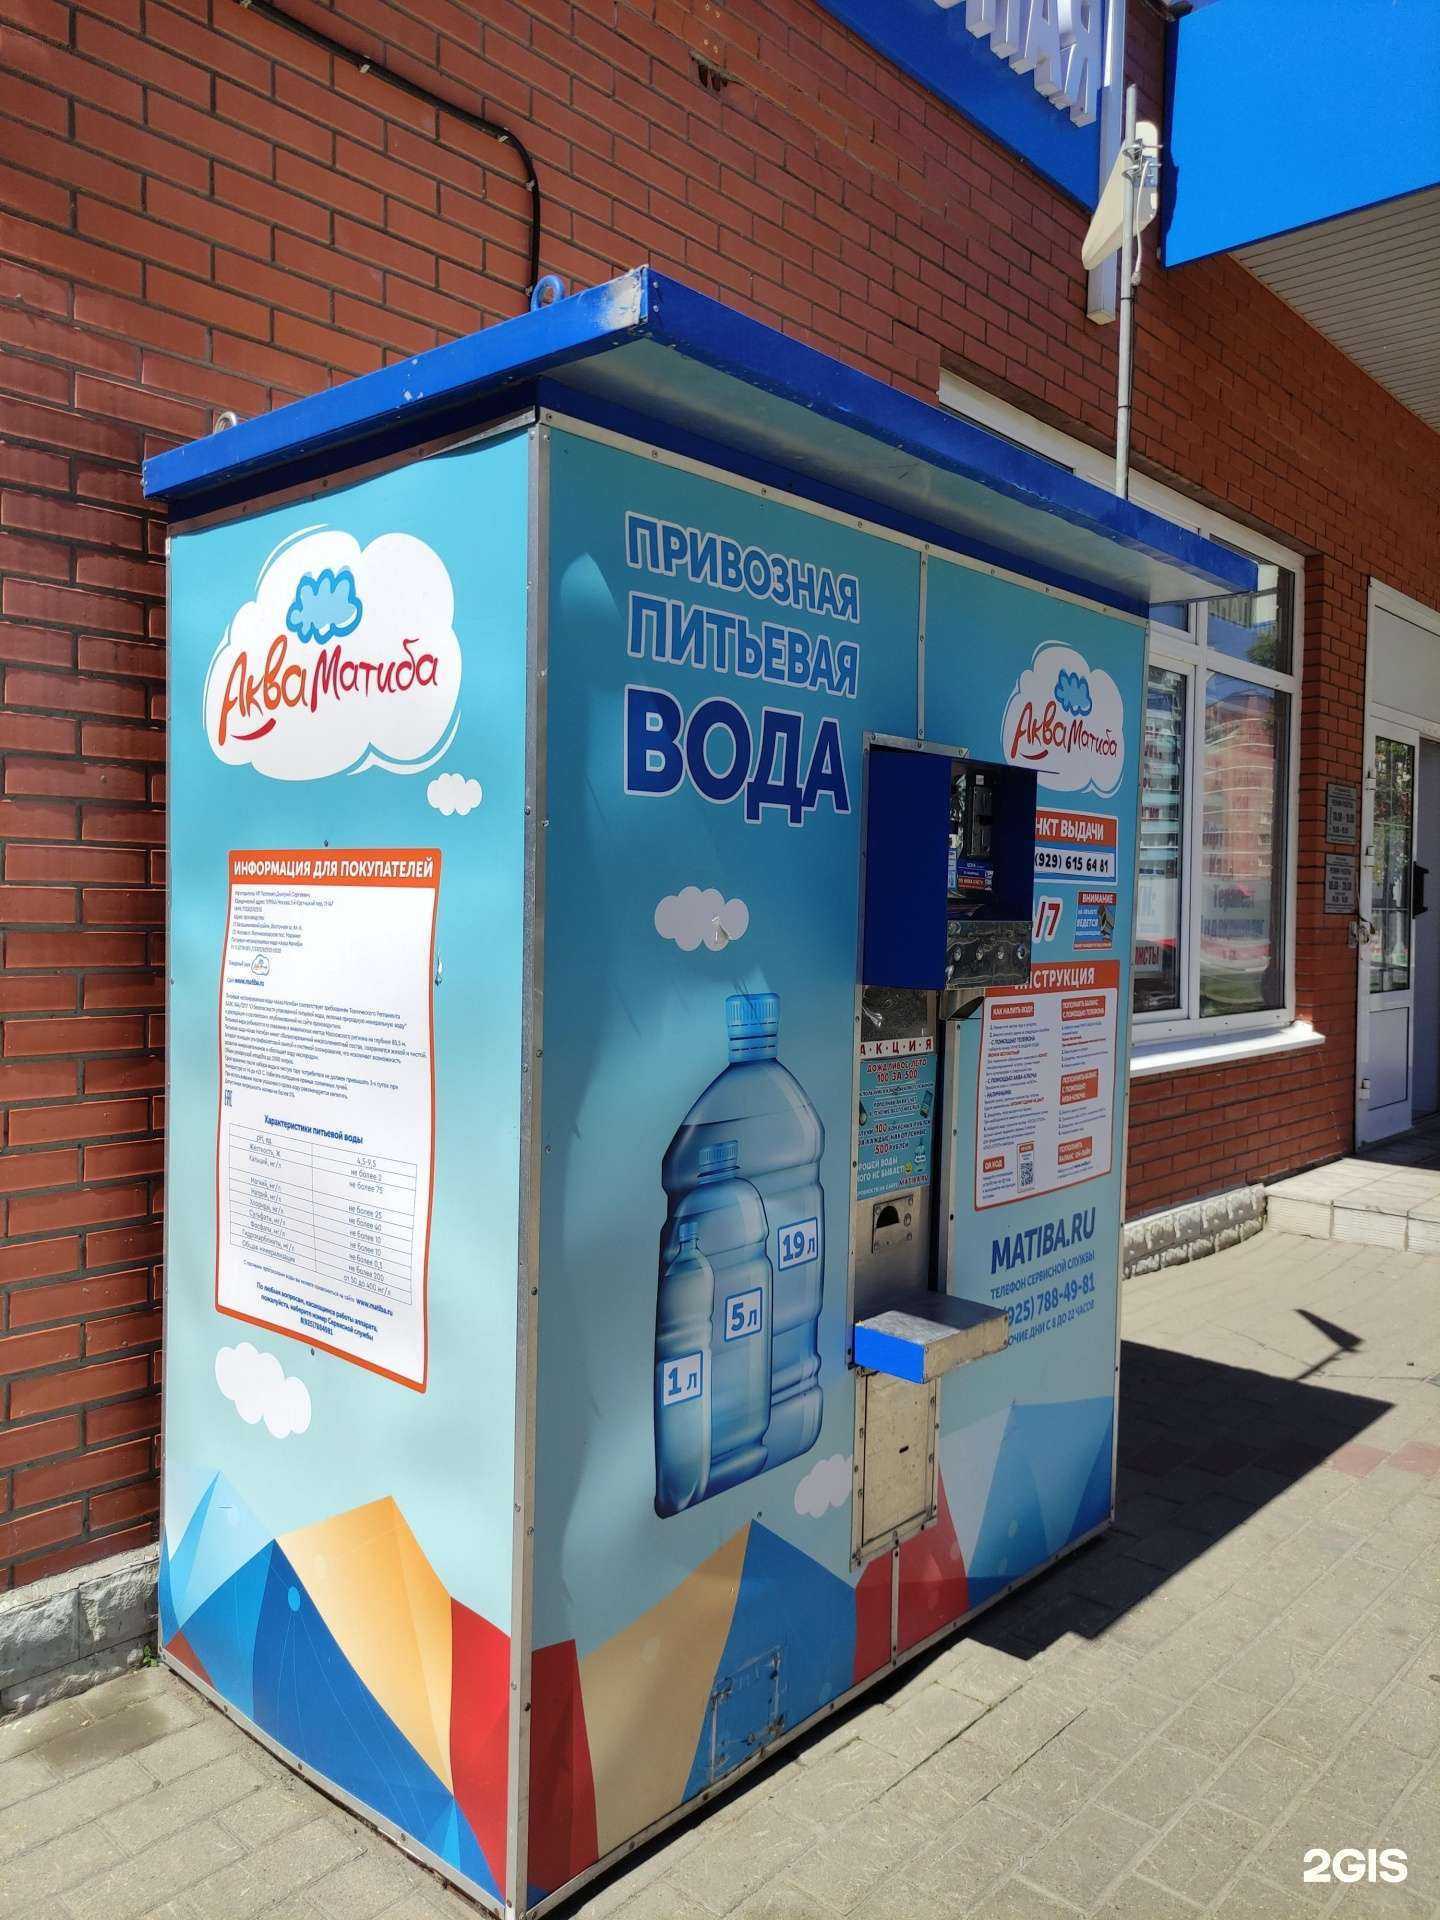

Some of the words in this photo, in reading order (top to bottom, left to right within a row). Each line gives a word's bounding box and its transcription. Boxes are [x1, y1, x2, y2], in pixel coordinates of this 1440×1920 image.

[625, 511, 860, 623] ПРИВОЗНАЯ
[627, 591, 859, 698] ПИТЬЕВАЯ
[624, 684, 850, 827] ВОДА
[1061, 820, 1104, 842] ВЫДАЧИ
[234, 860, 311, 878] ИНФОРМАЦИЯ
[313, 861, 338, 879] ДЛЯ
[340, 857, 433, 878] ПОКУПАТЕЛЕЙ
[1066, 856, 1082, 870] 615
[1033, 899, 1062, 940] /7
[1014, 967, 1095, 989] СТРУКЦИЯ
[312, 1127, 343, 1141] питьевой
[344, 1133, 364, 1145] воды
[782, 1230, 805, 1262] 19
[990, 1206, 1096, 1275] MATIBA.RU
[990, 1278, 1027, 1300] ТЕЛЕФОН
[1027, 1260, 1067, 1288] СЕРВИСНОЙ
[1067, 1250, 1095, 1271] СЛУЖБЫ
[1037, 1271, 1096, 1316] 788-49-81
[730, 1302, 745, 1332] 5
[1008, 1329, 1029, 1347] ОЧИЕ
[1029, 1322, 1045, 1340] ДНИ
[668, 1366, 682, 1397] 1
